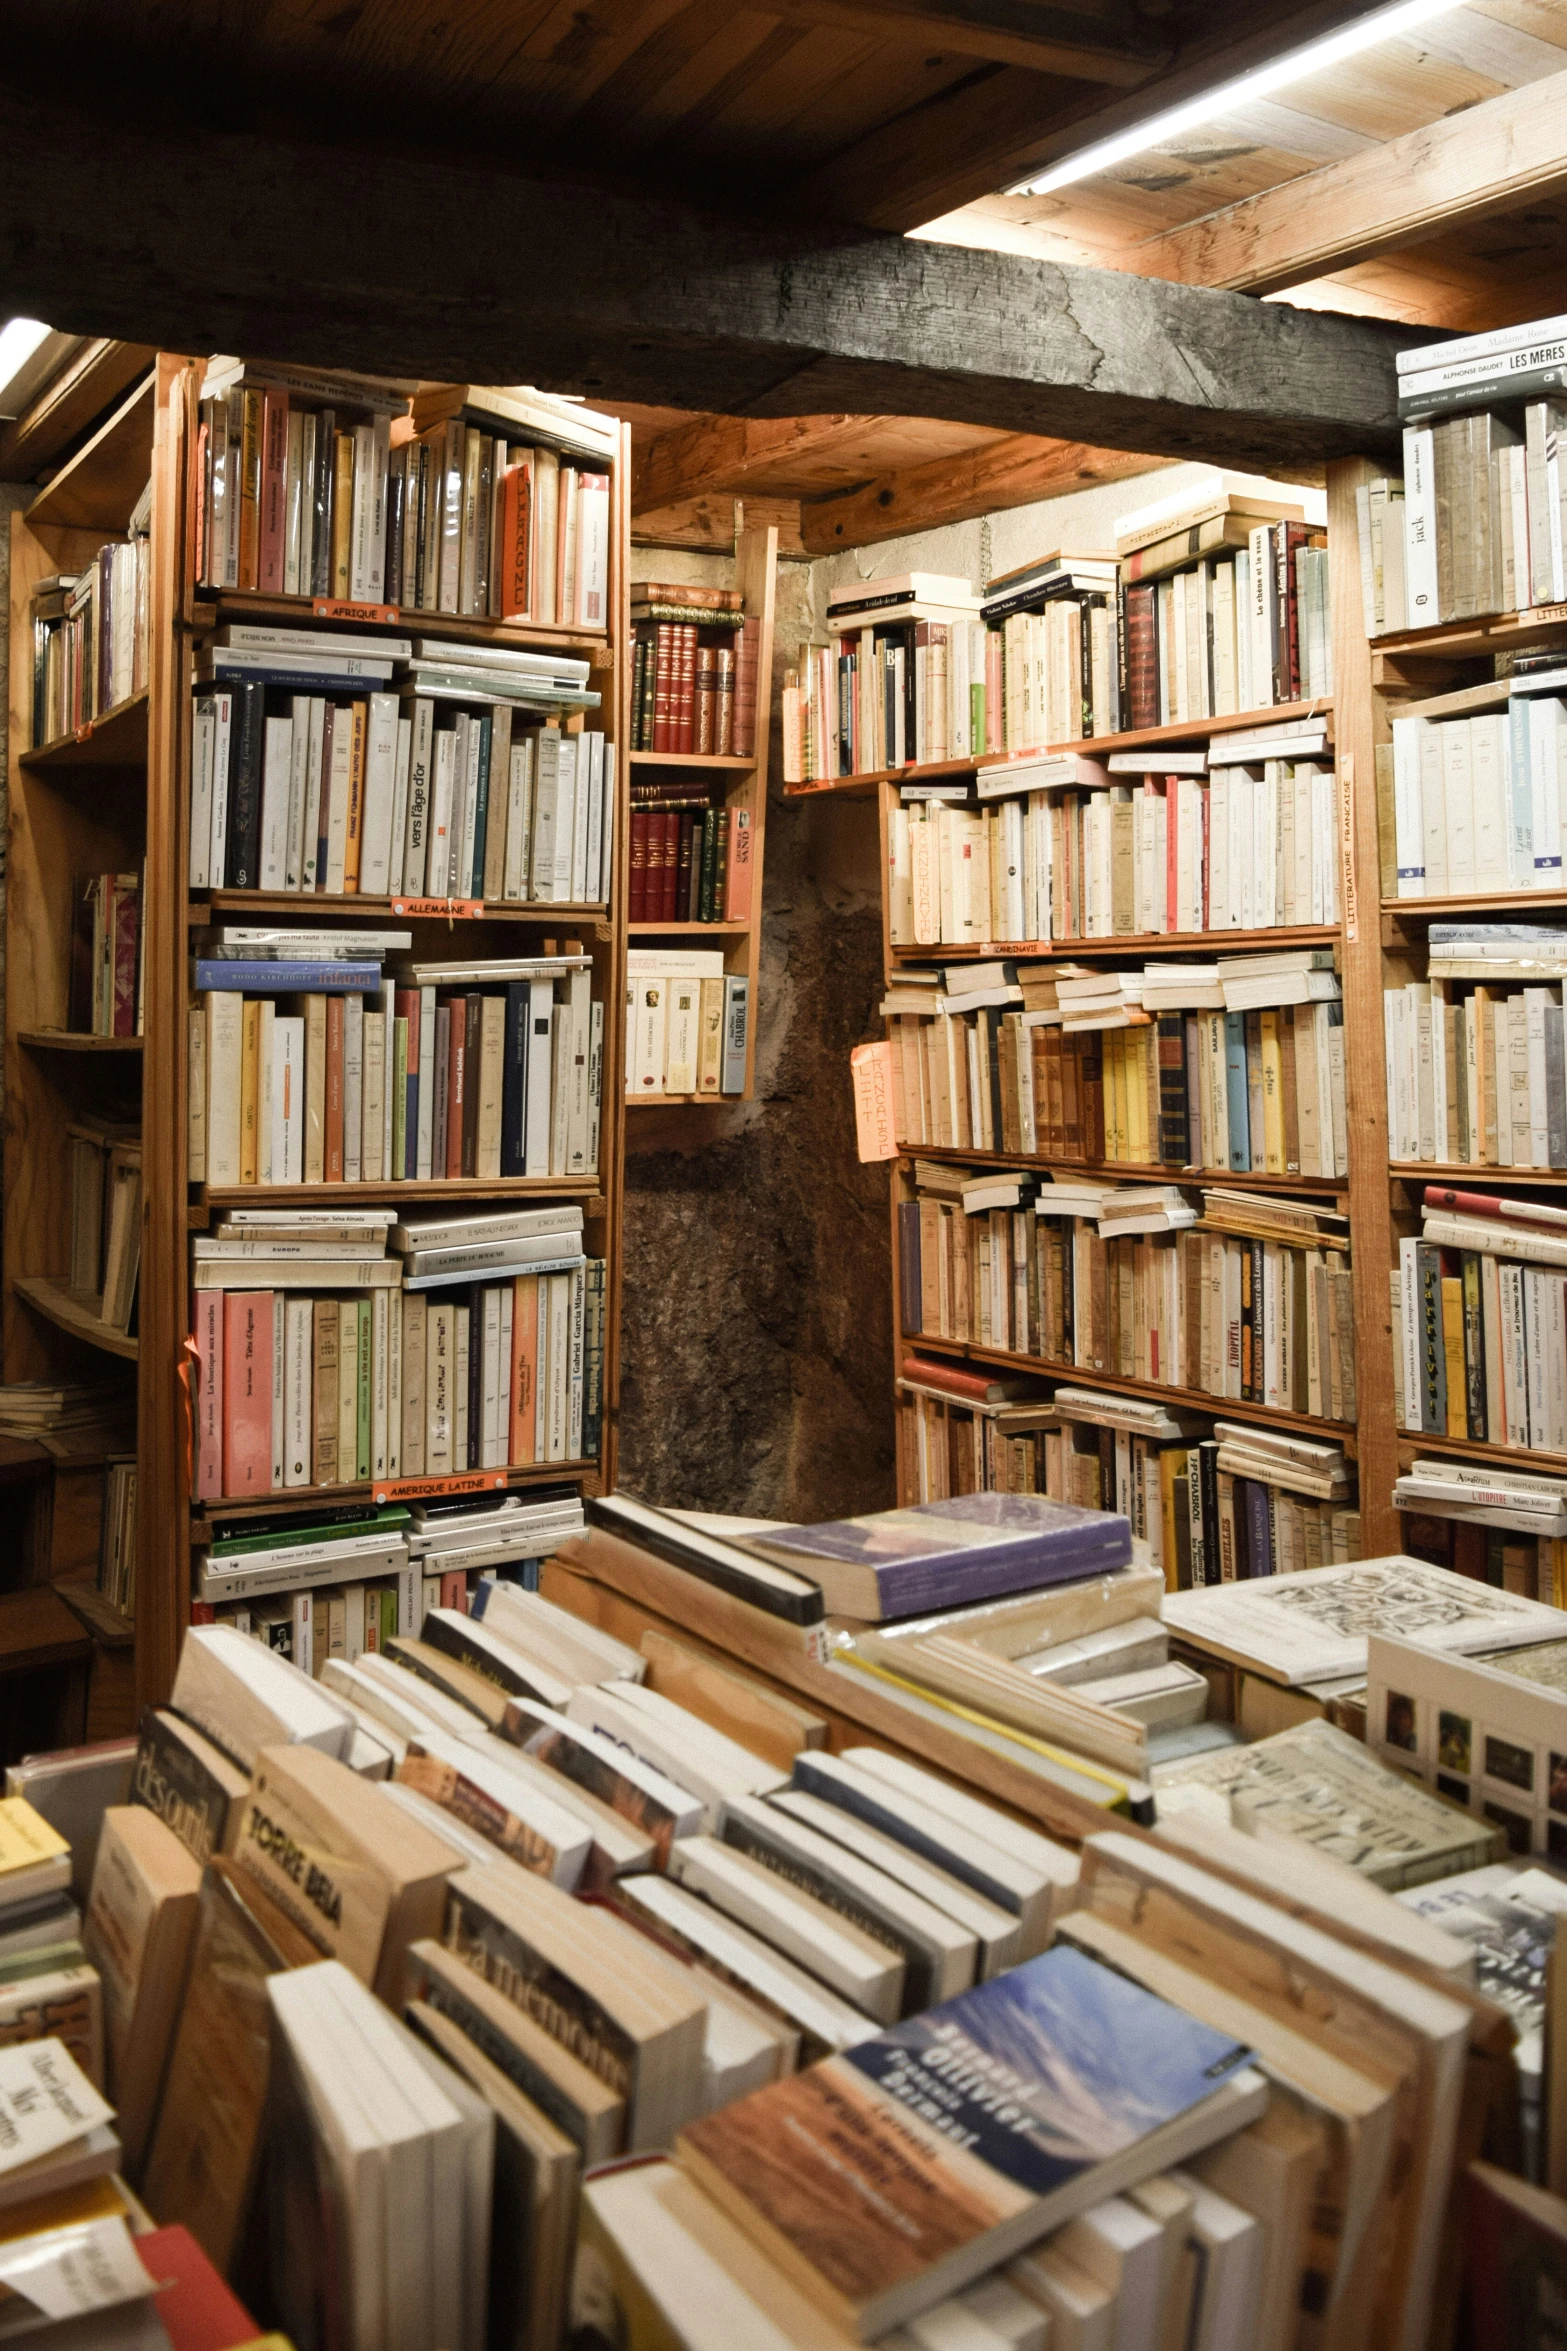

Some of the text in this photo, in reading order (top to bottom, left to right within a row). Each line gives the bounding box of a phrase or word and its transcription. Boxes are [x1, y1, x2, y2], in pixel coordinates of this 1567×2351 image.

[1489, 332, 1524, 347] Madame
[1527, 327, 1548, 339] Rose
[1443, 367, 1476, 380] ALPHONSE
[1478, 362, 1503, 373] DAUDET
[1509, 353, 1527, 370] LES
[1412, 515, 1427, 544] jack
[1257, 566, 1263, 575] et
[1256, 579, 1264, 603] chêne
[332, 607, 378, 620] AFRIQUE
[1257, 605, 1264, 615] Le
[842, 731, 848, 741] LE
[410, 762, 426, 849] vers l'âge d'or
[1515, 825, 1523, 842] vent
[741, 830, 750, 864] SAND
[1343, 779, 1356, 924] LITTERATURE FRANCAISE
[407, 903, 466, 915] ALLEMAGNE
[343, 935, 378, 944] Magnusson
[993, 944, 1038, 954] SCANDINAVIE
[317, 970, 371, 986] infanta
[735, 1005, 746, 1049] CHABROL
[456, 1047, 464, 1103] Bernhard Schlink
[439, 1257, 447, 1265] LA
[1512, 1272, 1520, 1283] feu
[1280, 1289, 1286, 1297] de
[1514, 1285, 1520, 1293] de
[1533, 1297, 1539, 1305] de
[362, 1316, 370, 1335] tango
[573, 1274, 583, 1373] Gabriel Garcia Márquez
[1405, 1263, 1417, 1400] Georges-Patrick Le temps en héritage
[1514, 1324, 1521, 1333] Le
[362, 1337, 369, 1348] un
[1254, 1326, 1263, 1390] BOUDARD Le
[1515, 1338, 1524, 1368] Gougaud
[207, 1352, 216, 1384] boutique
[295, 1370, 303, 1382] dans
[207, 1386, 215, 1395] La
[553, 1426, 560, 1434] Le
[1135, 1448, 1143, 1486] cavanna
[390, 1478, 485, 1497] AMERIQUE LATINE
[1190, 1457, 1200, 1523] J-P CHABROL
[1504, 1481, 1566, 1495] CHRISTIAN LABORDE
[1472, 1490, 1551, 1507] L'UTOPITRE Marc Jolivet
[1254, 1499, 1264, 1551] LA BANQUISE
[1221, 1518, 1233, 1579] REBELLES
[248, 1807, 309, 1891] TORRE
[447, 1897, 490, 1979] La
